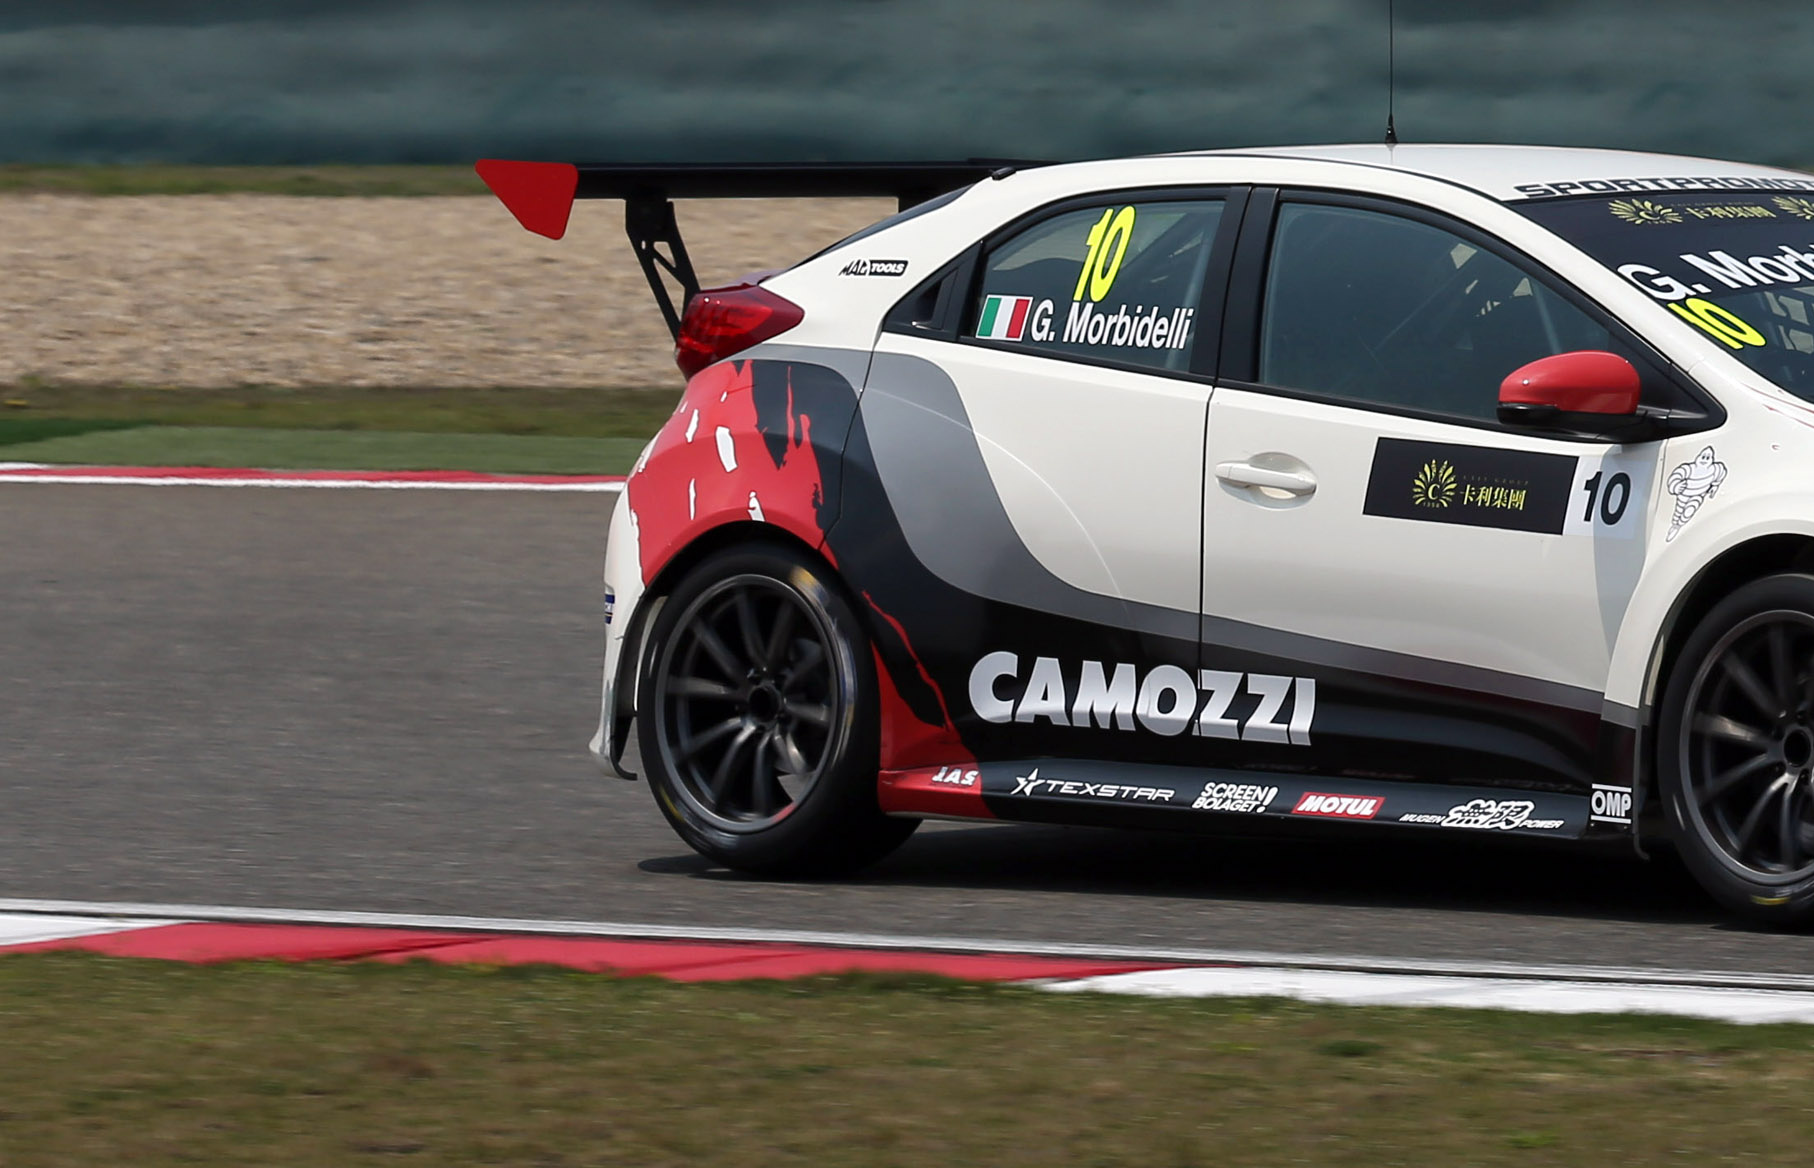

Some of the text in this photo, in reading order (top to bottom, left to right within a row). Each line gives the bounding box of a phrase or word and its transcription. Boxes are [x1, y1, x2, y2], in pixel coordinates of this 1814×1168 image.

[871, 262, 905, 274] TOOLS
[1073, 205, 1136, 302] 10
[1616, 263, 1711, 301] G.
[1031, 299, 1194, 349] G. Morbidelli
[1667, 298, 1766, 350] 10
[1584, 471, 1631, 525] 10
[968, 651, 1315, 746] CAMOZZI
[1047, 780, 1175, 801] TEXSTAR
[1297, 795, 1377, 816] MOTUL
[1591, 790, 1631, 817] OMP
[1399, 813, 1446, 824] MUGEN
[1518, 819, 1565, 829] POWER
